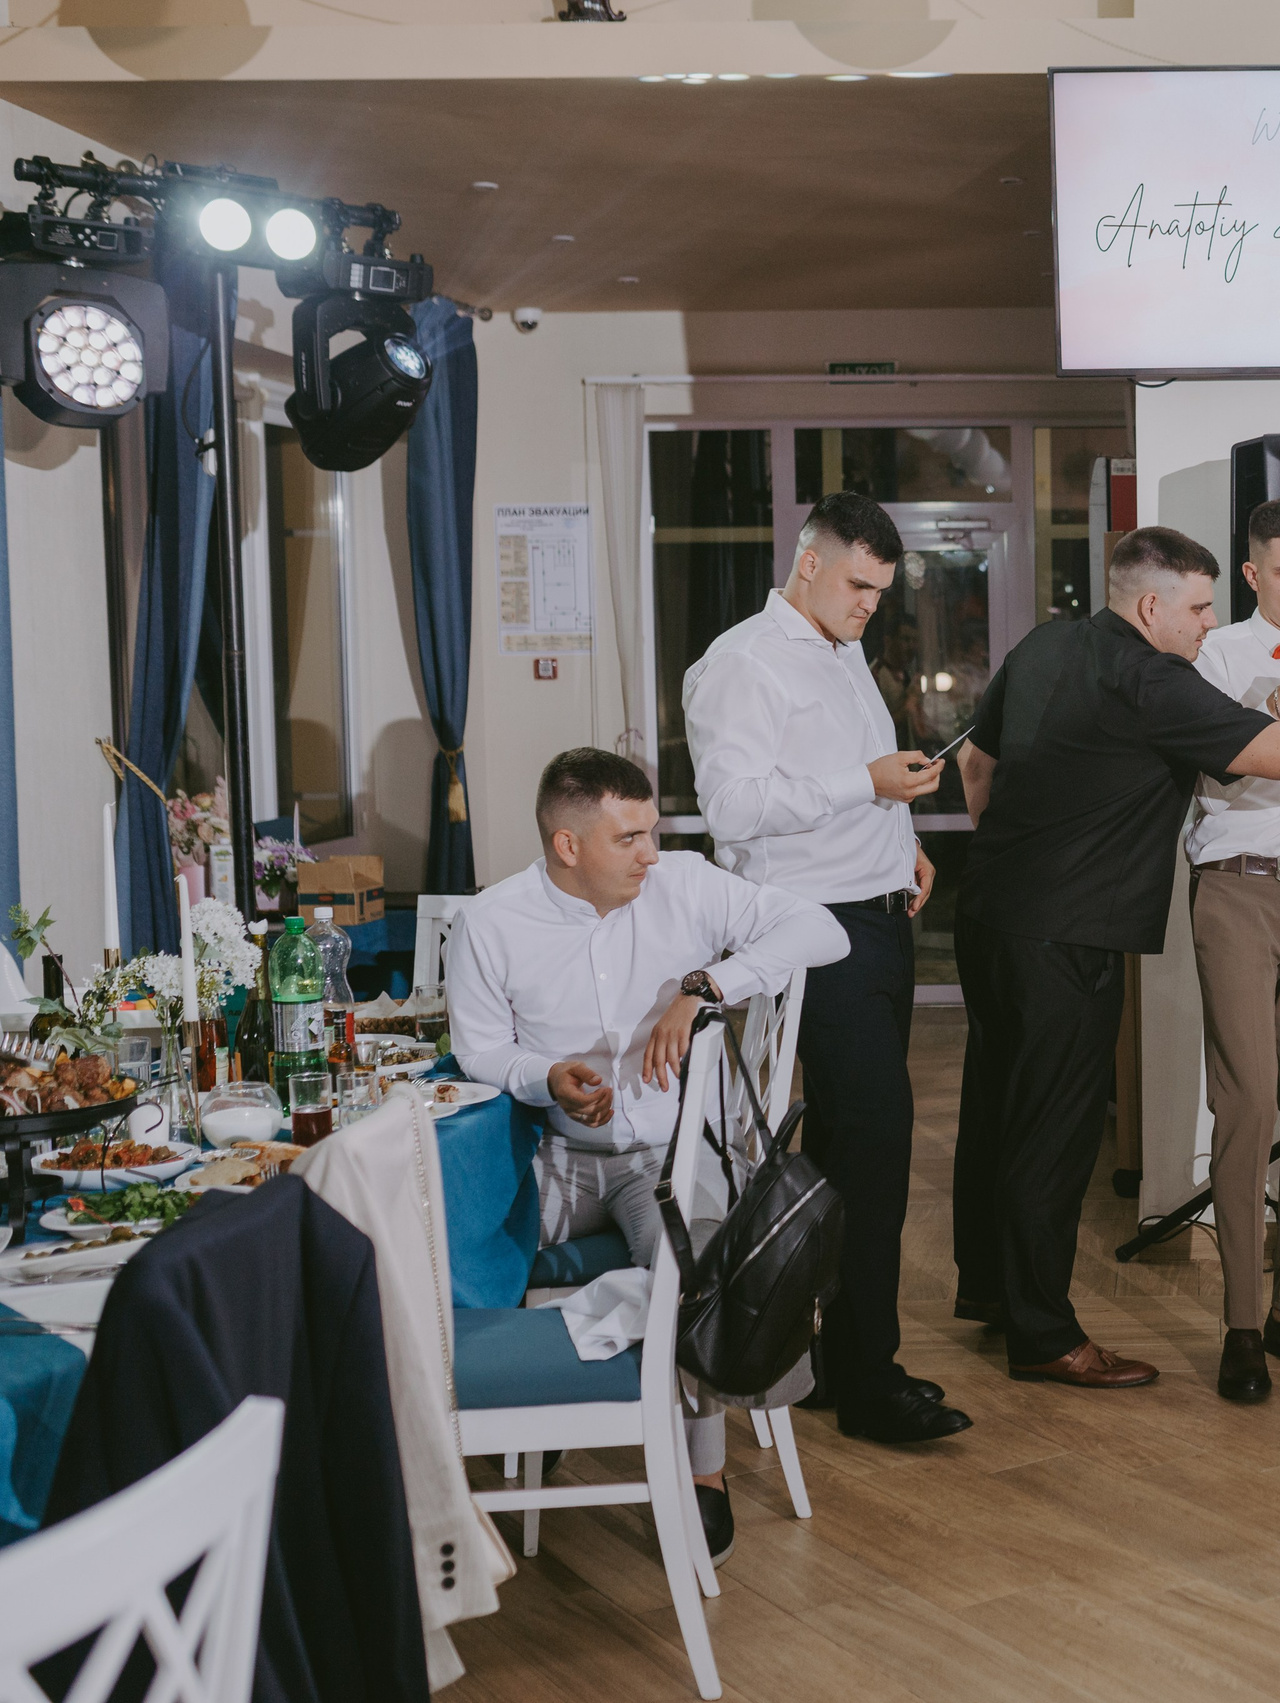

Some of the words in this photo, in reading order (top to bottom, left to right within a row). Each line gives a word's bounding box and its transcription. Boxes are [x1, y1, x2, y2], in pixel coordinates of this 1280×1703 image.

[1095, 183, 1259, 284] Anatoliy
[497, 507, 525, 517] ПЛАН
[529, 506, 589, 517] ЭВАКУАЦИИ
